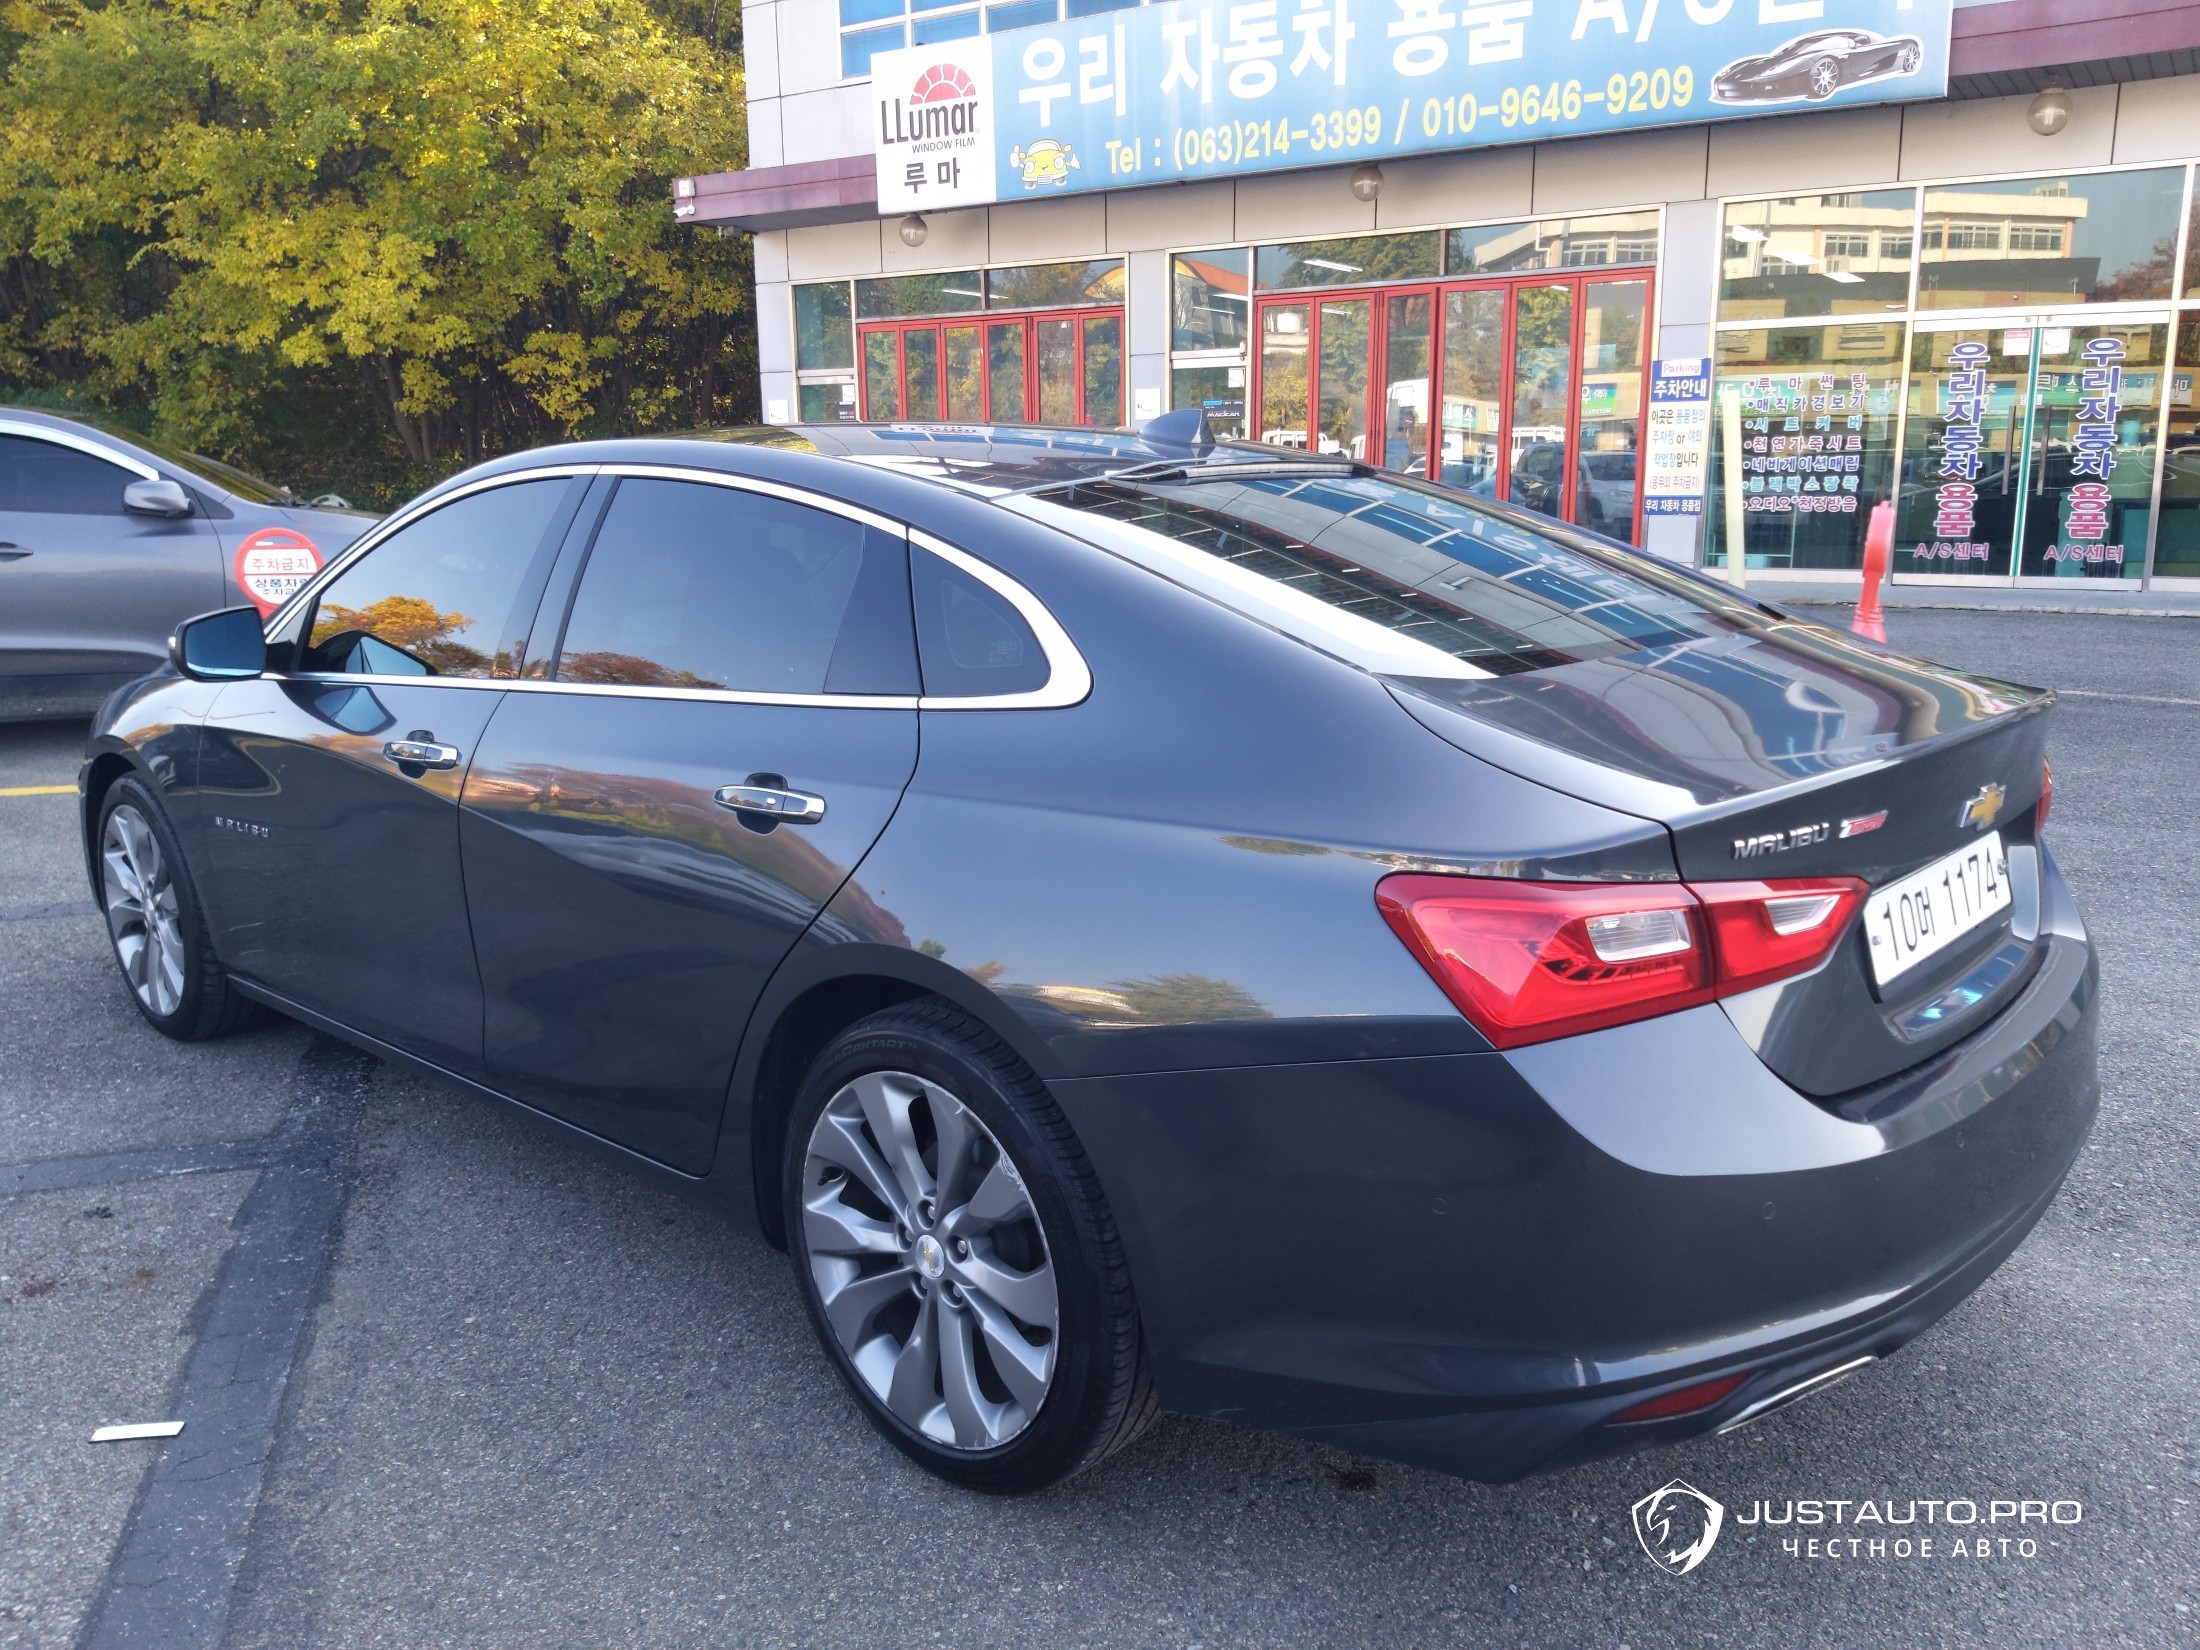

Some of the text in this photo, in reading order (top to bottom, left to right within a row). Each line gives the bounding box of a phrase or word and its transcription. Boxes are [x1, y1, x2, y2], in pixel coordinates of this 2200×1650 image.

[1019, 24, 1126, 127] 우리
[1160, 0, 1356, 104] 자동차
[881, 98, 978, 145] LLumar
[1174, 105, 1382, 172] (063)214-3399
[1422, 65, 1695, 137] 010-9646-9209
[912, 136, 976, 154] WINDOW FILM
[1663, 363, 1700, 374] Parking
[1653, 378, 1707, 399] 주차안내
[1651, 408, 1674, 425] 이곳은
[1651, 428, 1675, 446] 주차장
[1676, 434, 1685, 445] or
[1645, 499, 1702, 513] 우리 자동차 용품점
[1933, 482, 1977, 538] 용품
[2065, 482, 2111, 539] 용품
[1912, 542, 1990, 561] A/S센터
[2043, 544, 2124, 563] A/S센터
[251, 557, 309, 571] 주차금지
[1732, 823, 1830, 860] MALIBU
[1942, 847, 1998, 926] 1174
